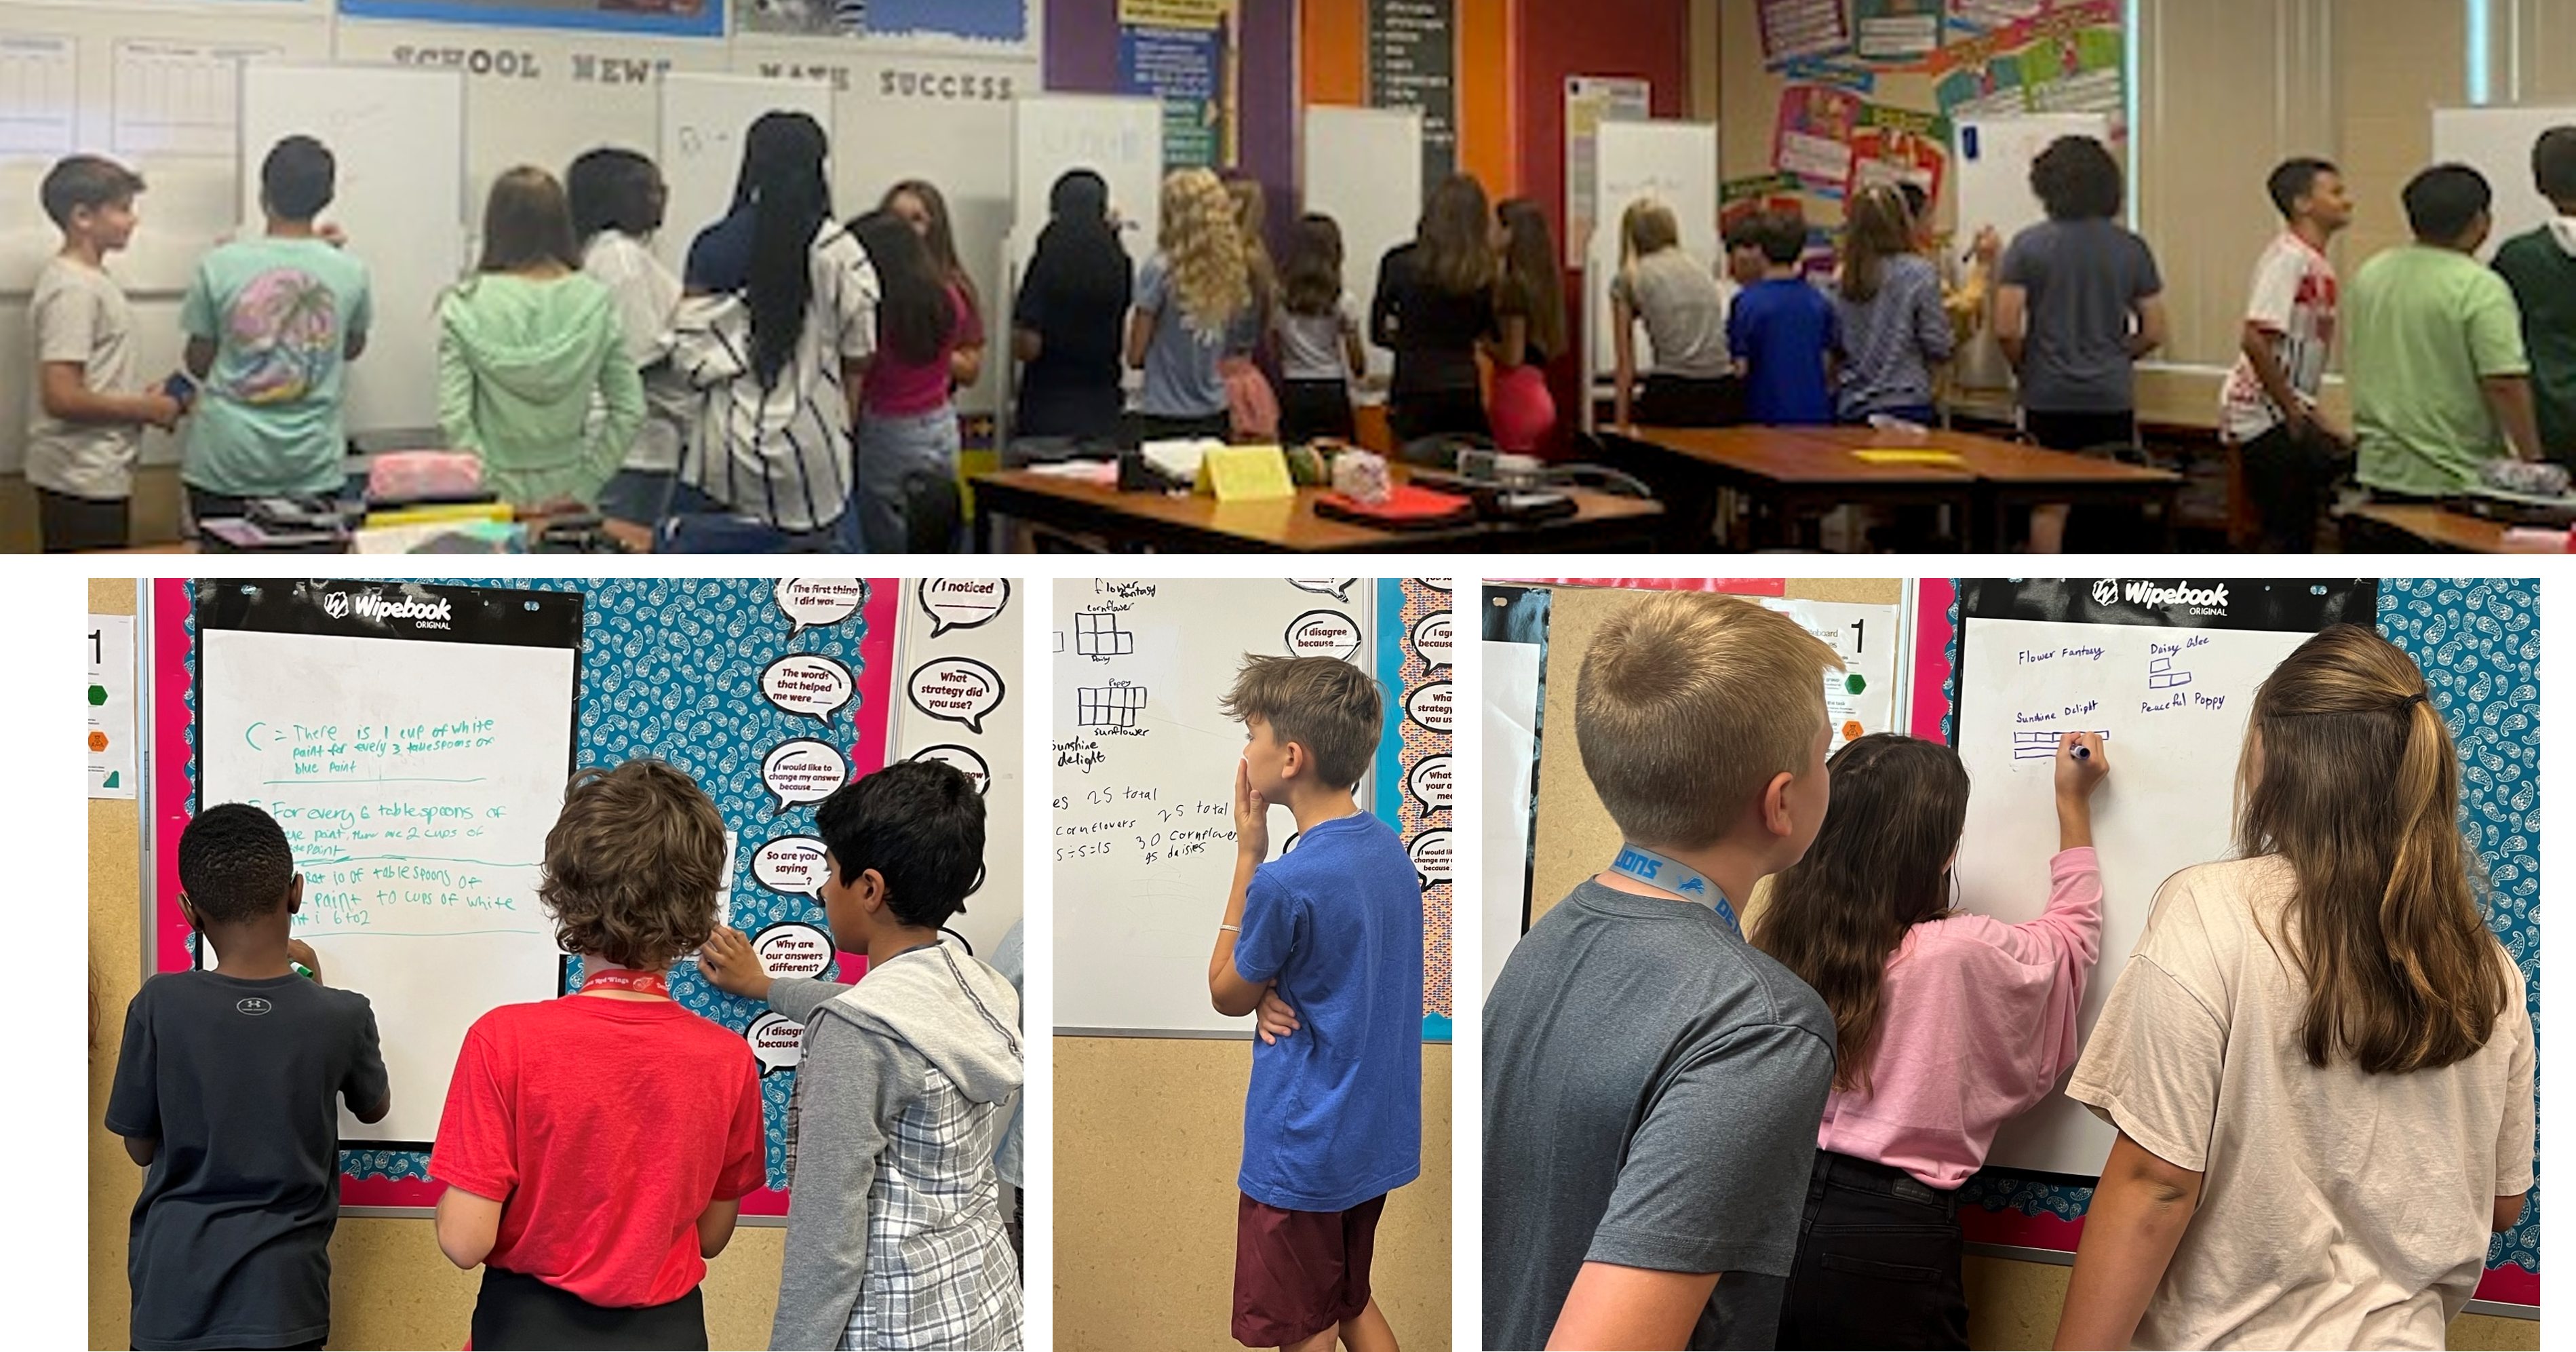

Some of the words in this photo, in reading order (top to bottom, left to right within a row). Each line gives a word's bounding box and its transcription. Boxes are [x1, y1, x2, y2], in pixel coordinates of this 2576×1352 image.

[880, 70, 1012, 100] SUCCESS
[794, 585, 809, 593] The
[812, 585, 832, 594] first
[833, 585, 857, 596] thing
[941, 581, 946, 591] I
[948, 581, 994, 594] noticed
[800, 596, 815, 605] did
[2125, 580, 2229, 609] Wipebook
[355, 594, 452, 622] Wipebook
[2189, 607, 2228, 616] ORIGINAL
[416, 621, 451, 630] ORIGINAL
[1309, 627, 1347, 638] disagree
[1851, 619, 1864, 653] 1
[88, 630, 101, 664] 1
[1418, 639, 1452, 647] because
[2018, 650, 2056, 665] Flower
[2062, 645, 2105, 661] Fantasy
[2150, 644, 2182, 657] Daisy
[783, 668, 799, 677] The
[801, 670, 829, 680] words
[941, 672, 967, 682] What
[777, 680, 798, 689] that
[800, 680, 832, 693] helped
[921, 685, 964, 697] strategy
[966, 687, 983, 697] did
[789, 694, 812, 702] were
[929, 699, 948, 709] you
[950, 701, 972, 710] use?
[2195, 693, 2225, 710] Poppy
[293, 725, 337, 741] There
[357, 725, 370, 739] is
[400, 725, 425, 739] cup
[432, 723, 449, 737] of
[451, 716, 494, 735] white
[1094, 726, 1150, 736] sunflower
[293, 743, 324, 760] paint
[328, 742, 347, 754] for
[392, 744, 401, 755] 3
[295, 761, 319, 775] blue
[1057, 750, 1106, 773] delight
[768, 773, 798, 781] change
[1123, 786, 1157, 800] total
[1196, 800, 1228, 815] total
[272, 802, 305, 819] For
[307, 807, 355, 829] every
[360, 805, 370, 819] 6
[378, 802, 474, 825] tablespoons
[486, 806, 507, 819] of
[406, 827, 420, 840] 2
[424, 828, 457, 839] cups
[467, 826, 484, 836] of
[767, 851, 779, 860] So
[800, 853, 818, 862] you
[1167, 842, 1207, 858] daisies
[350, 868, 364, 883] of
[776, 864, 808, 875] saying
[405, 891, 432, 905] cups
[466, 895, 516, 911] white
[776, 940, 796, 950] Why
[769, 963, 819, 971] different?
[766, 1027, 770, 1035] I
[772, 1026, 804, 1038] disagr
[758, 1039, 799, 1047] because
